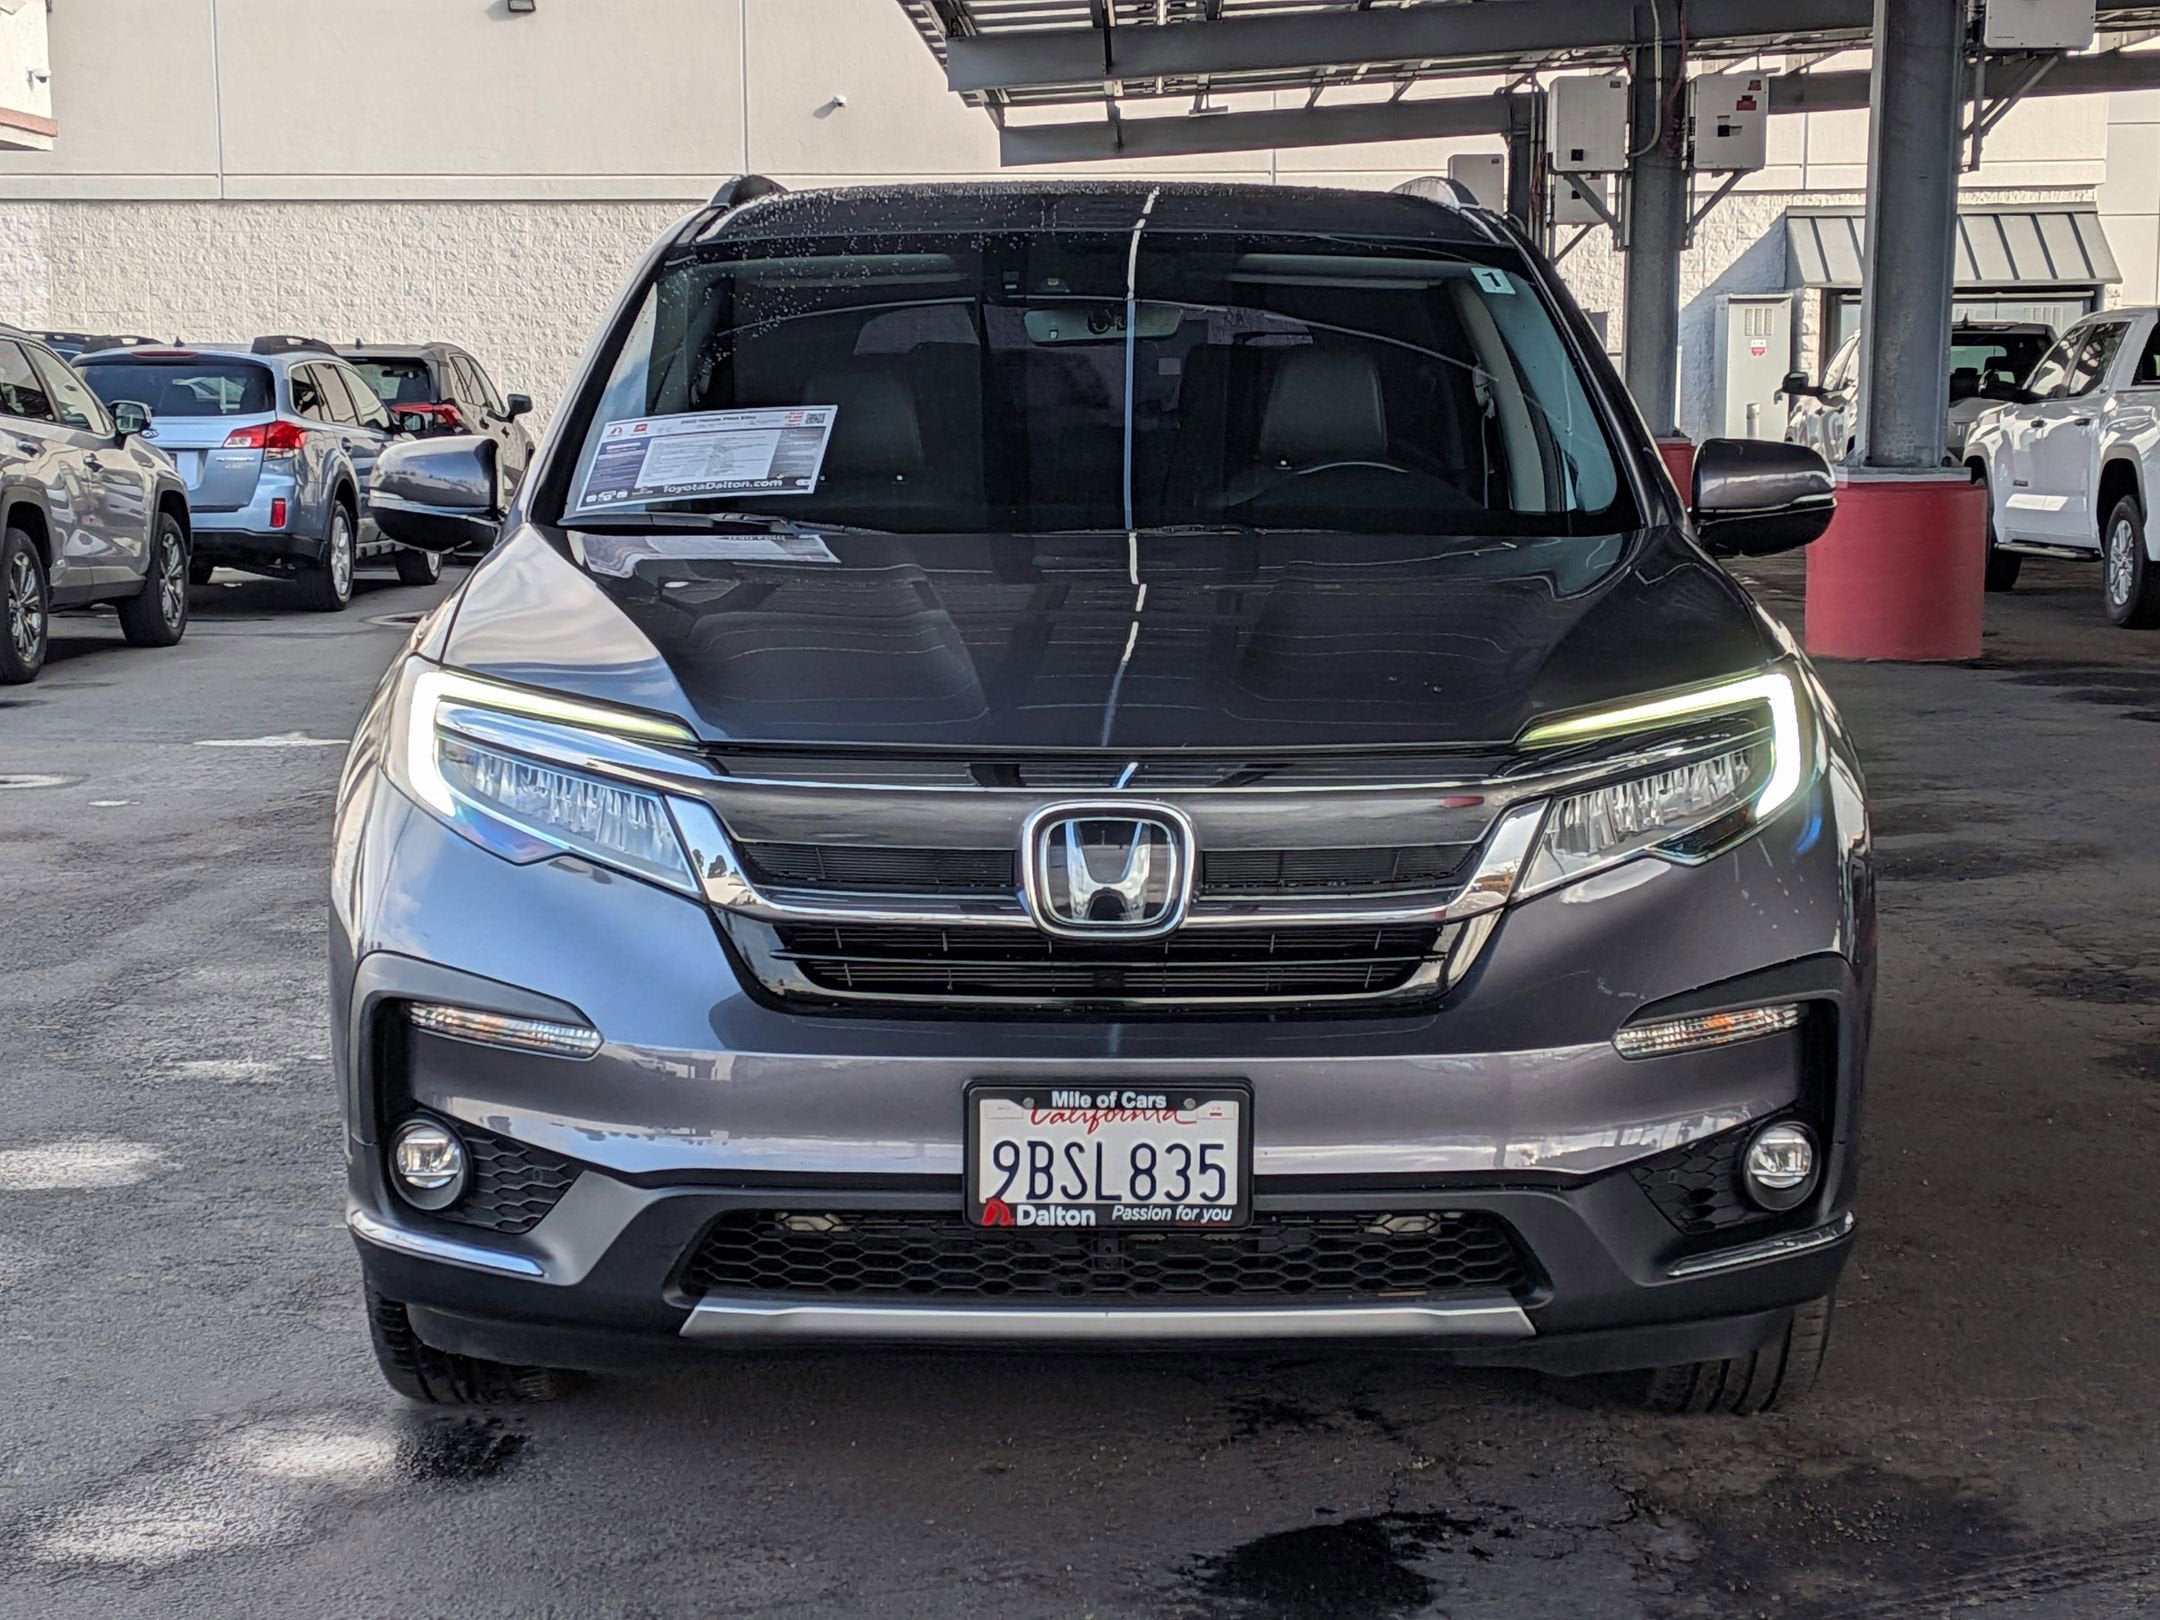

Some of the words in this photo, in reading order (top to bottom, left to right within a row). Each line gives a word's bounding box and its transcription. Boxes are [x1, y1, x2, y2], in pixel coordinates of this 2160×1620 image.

[663, 479, 783, 494] ToyotaDalton.com
[1051, 1091, 1092, 1108] Mile
[1096, 1091, 1118, 1109] of
[1122, 1092, 1167, 1109] Cars
[992, 1140, 1227, 1202] 9BSL835
[1016, 1205, 1096, 1227] Dalton
[1112, 1205, 1171, 1221] Passion
[1175, 1205, 1199, 1221] for
[1200, 1208, 1233, 1223] you
